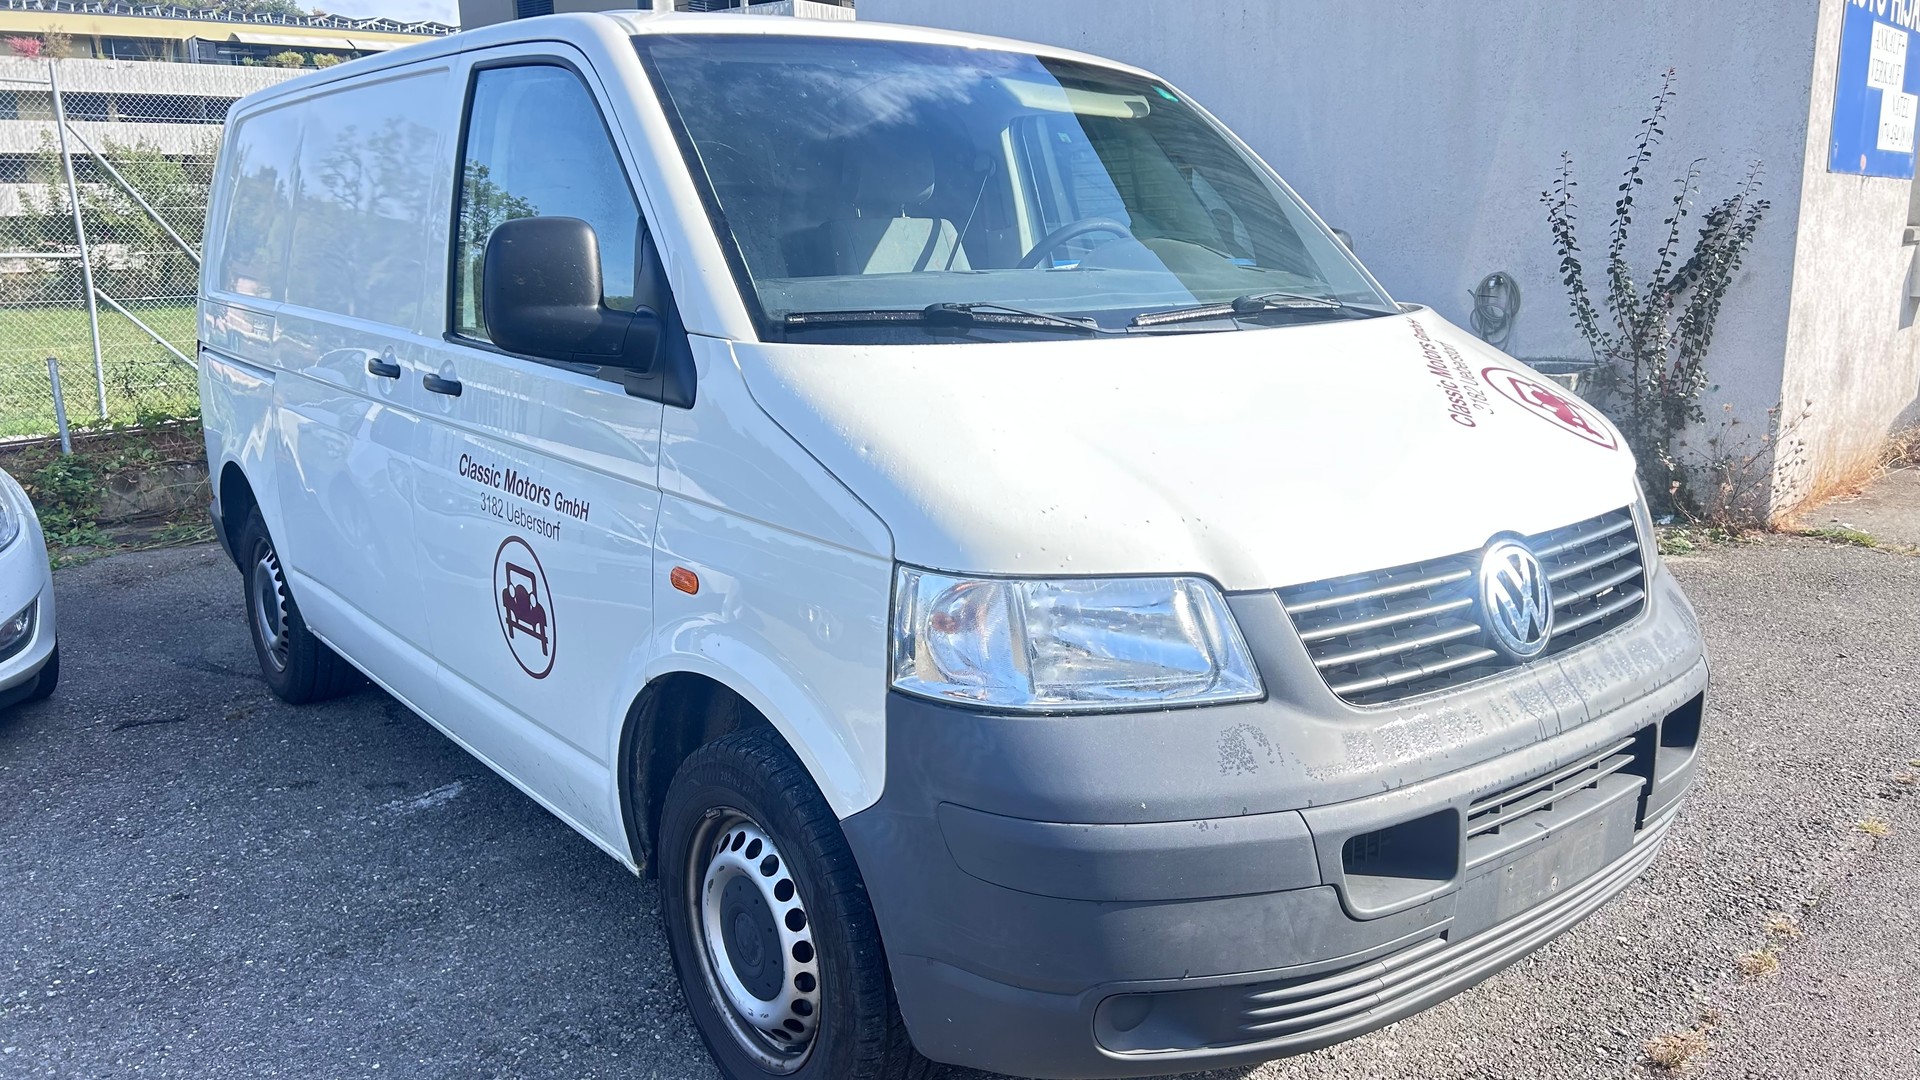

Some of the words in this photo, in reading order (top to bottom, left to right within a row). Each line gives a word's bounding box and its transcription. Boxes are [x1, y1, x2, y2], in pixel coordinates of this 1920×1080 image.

[1418, 341, 1454, 380] Motors
[1436, 380, 1476, 428] Classic
[459, 453, 501, 489] Classic
[504, 468, 551, 507] Motors
[554, 491, 590, 522] GmbH
[480, 492, 504, 519] 3182
[506, 501, 561, 542] Ueberstorf
[1483, 545, 1550, 648] VW
